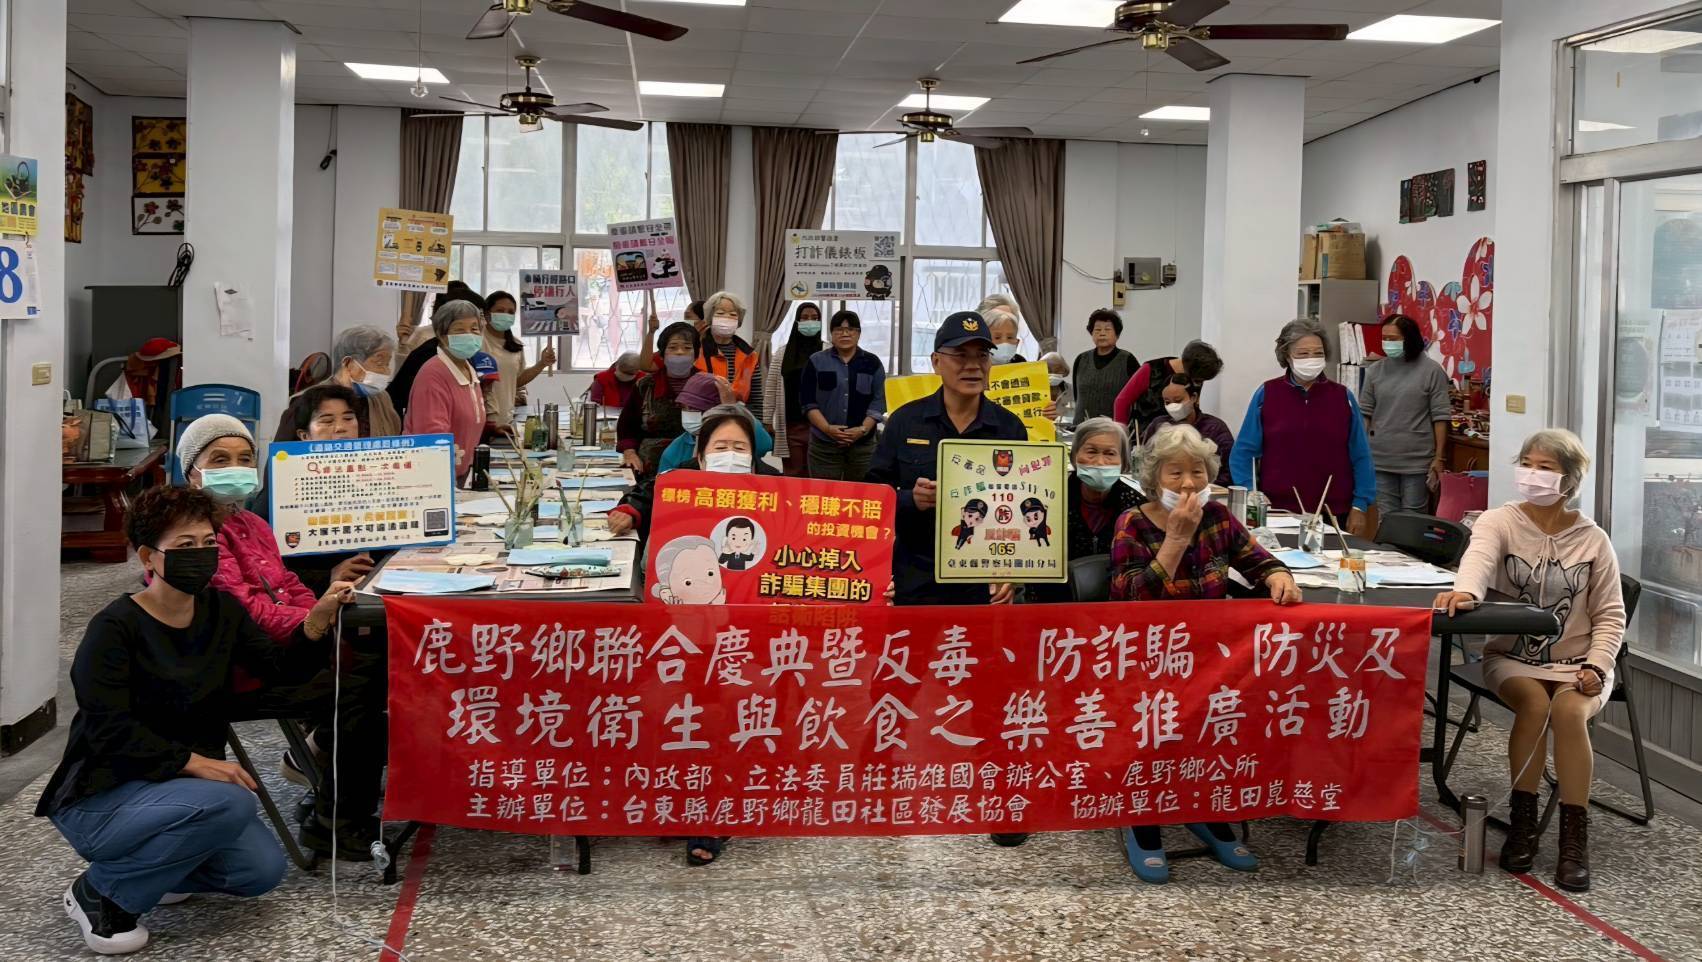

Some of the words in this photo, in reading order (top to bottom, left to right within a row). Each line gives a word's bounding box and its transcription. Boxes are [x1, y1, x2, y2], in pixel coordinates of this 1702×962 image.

[992, 493, 1014, 501] 110
[773, 544, 863, 572] 小心掉入
[989, 542, 1016, 556] 165
[759, 572, 872, 601] 詐騙集團的
[413, 618, 1406, 688] 鹿野鄉聯合慶典暨反毒、防詐騙、防災及
[447, 683, 1371, 754] 環境衛生與飲食之樂善推廣活動
